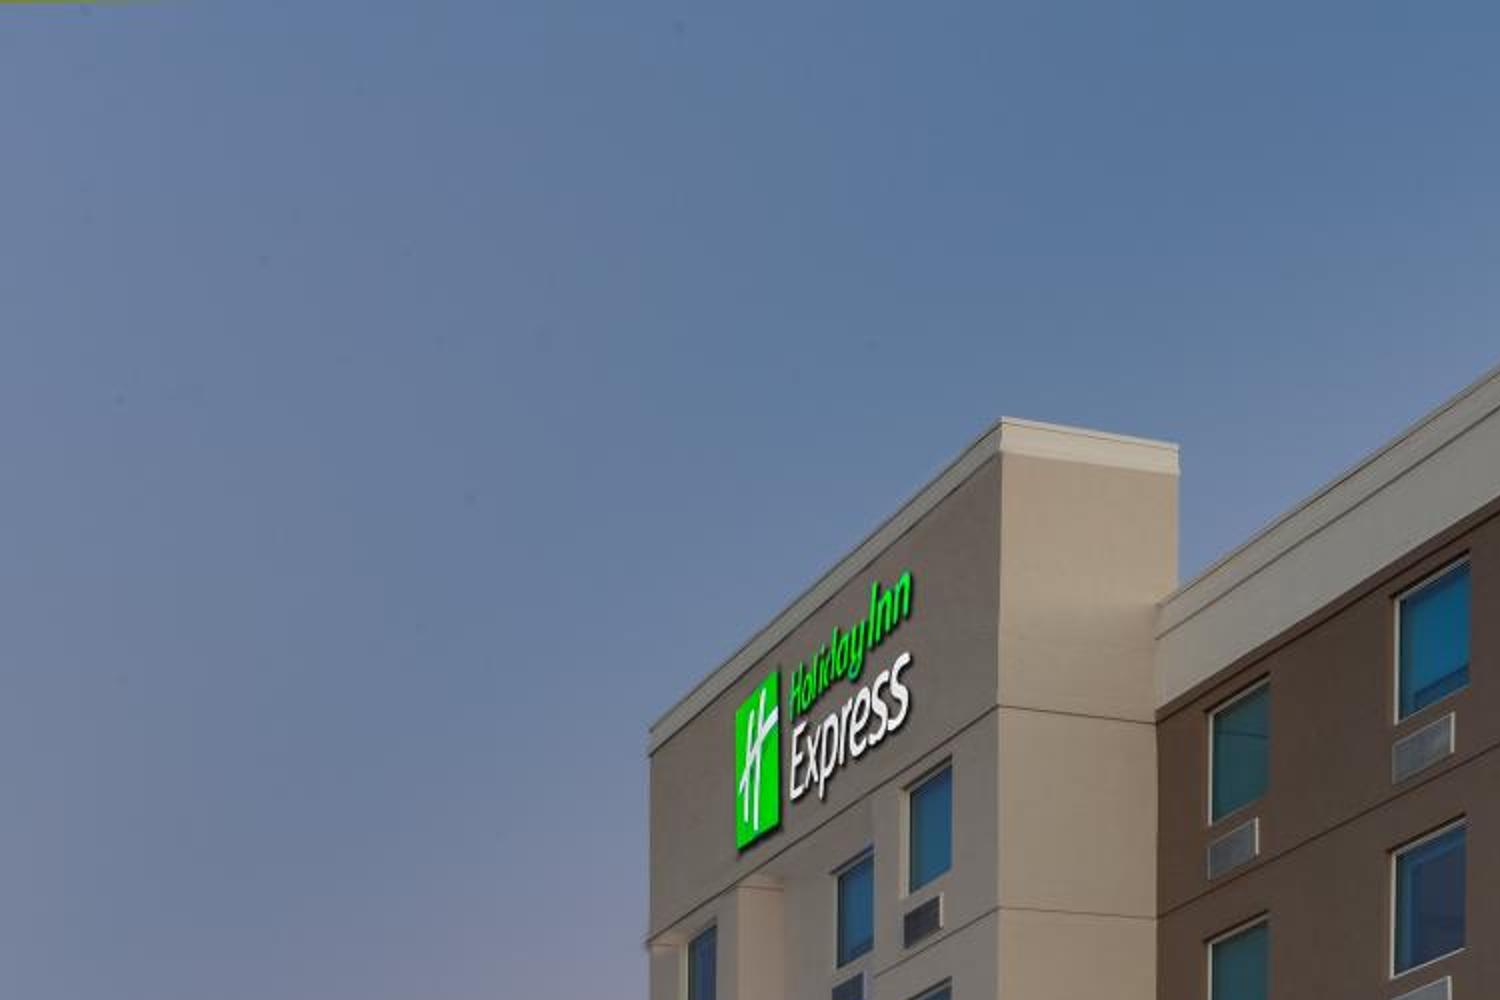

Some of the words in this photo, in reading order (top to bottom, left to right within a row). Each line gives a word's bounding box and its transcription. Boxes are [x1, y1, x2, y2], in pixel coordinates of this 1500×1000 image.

[789, 620, 866, 721] Holiday
[867, 570, 912, 649] Inn
[789, 652, 911, 801] Express
